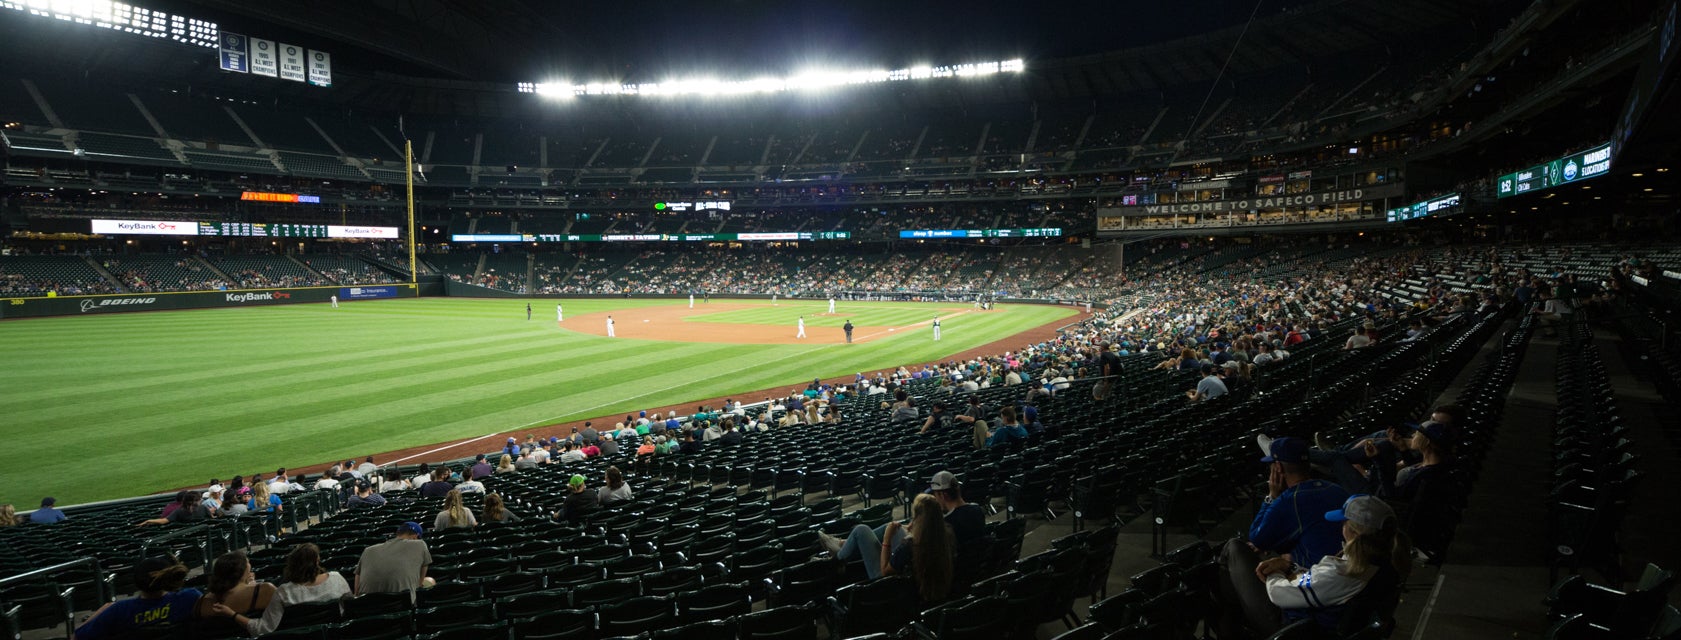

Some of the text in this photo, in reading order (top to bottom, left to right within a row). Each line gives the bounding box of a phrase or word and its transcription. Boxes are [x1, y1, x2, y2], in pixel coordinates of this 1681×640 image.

[253, 65, 276, 75] CHAMPIONS
[281, 70, 304, 80] CHAMPIONS
[310, 75, 331, 83] CHAMPIONS
[1501, 179, 1511, 193] 9:52
[1146, 189, 1363, 214] WELCOME TO SAFECO FIELD
[100, 298, 156, 306] BOEING
[226, 291, 273, 303] KeyBank
